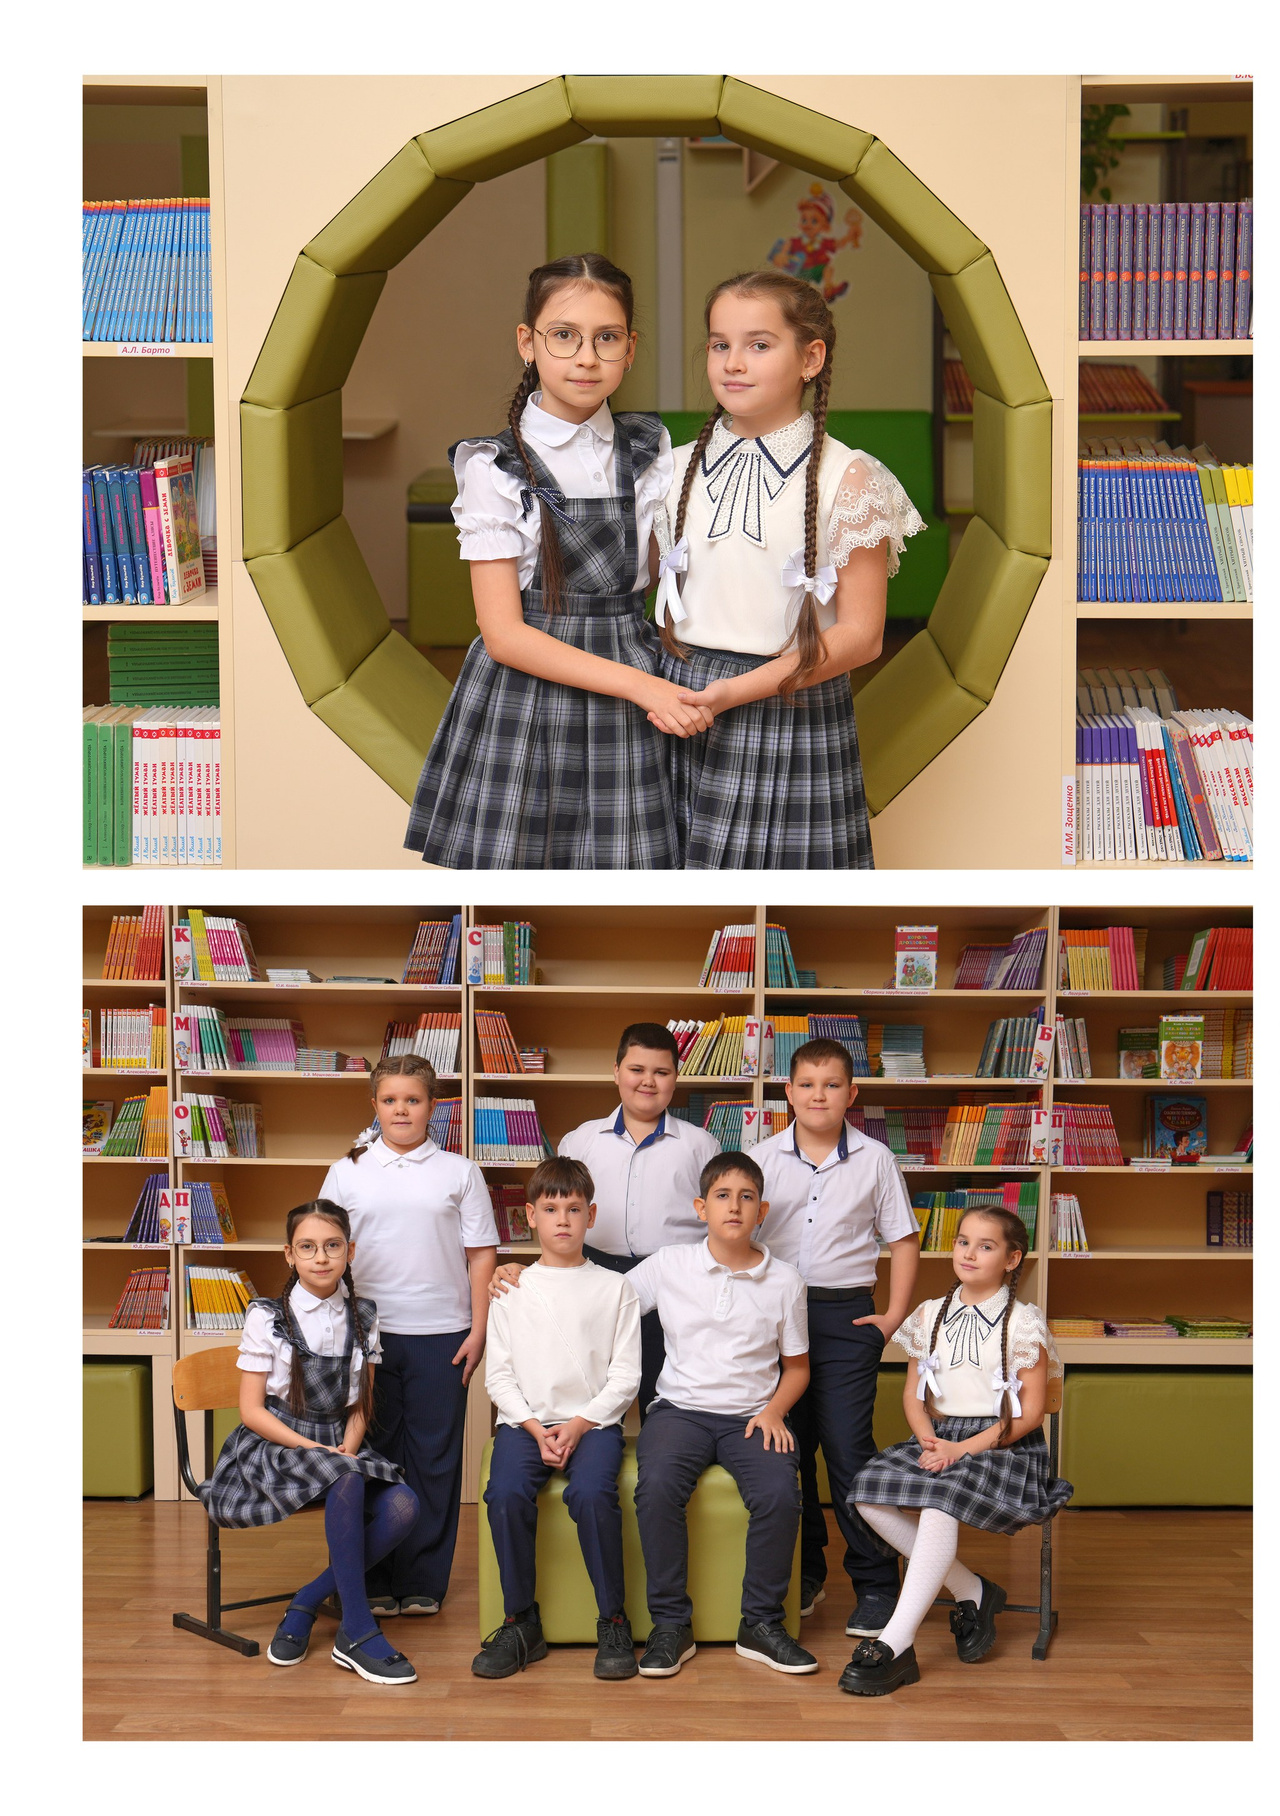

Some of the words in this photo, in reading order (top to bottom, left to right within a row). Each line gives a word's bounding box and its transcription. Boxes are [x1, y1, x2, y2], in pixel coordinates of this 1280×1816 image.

[122, 346, 139, 354] А.Л.
[141, 346, 170, 355] Барто
[1065, 785, 1075, 828] Зощенко
[1065, 830, 1073, 856] М.М.
[174, 928, 190, 942] К
[468, 931, 482, 945] С
[174, 1017, 190, 1030] М
[746, 1022, 759, 1036] Т
[764, 1025, 774, 1038] А
[1038, 1026, 1052, 1041] Б
[175, 1105, 189, 1119] О
[744, 1111, 758, 1125] У
[762, 1111, 772, 1125] В
[1034, 1111, 1048, 1124] Г
[1051, 1114, 1063, 1128] П
[175, 1192, 189, 1206] П
